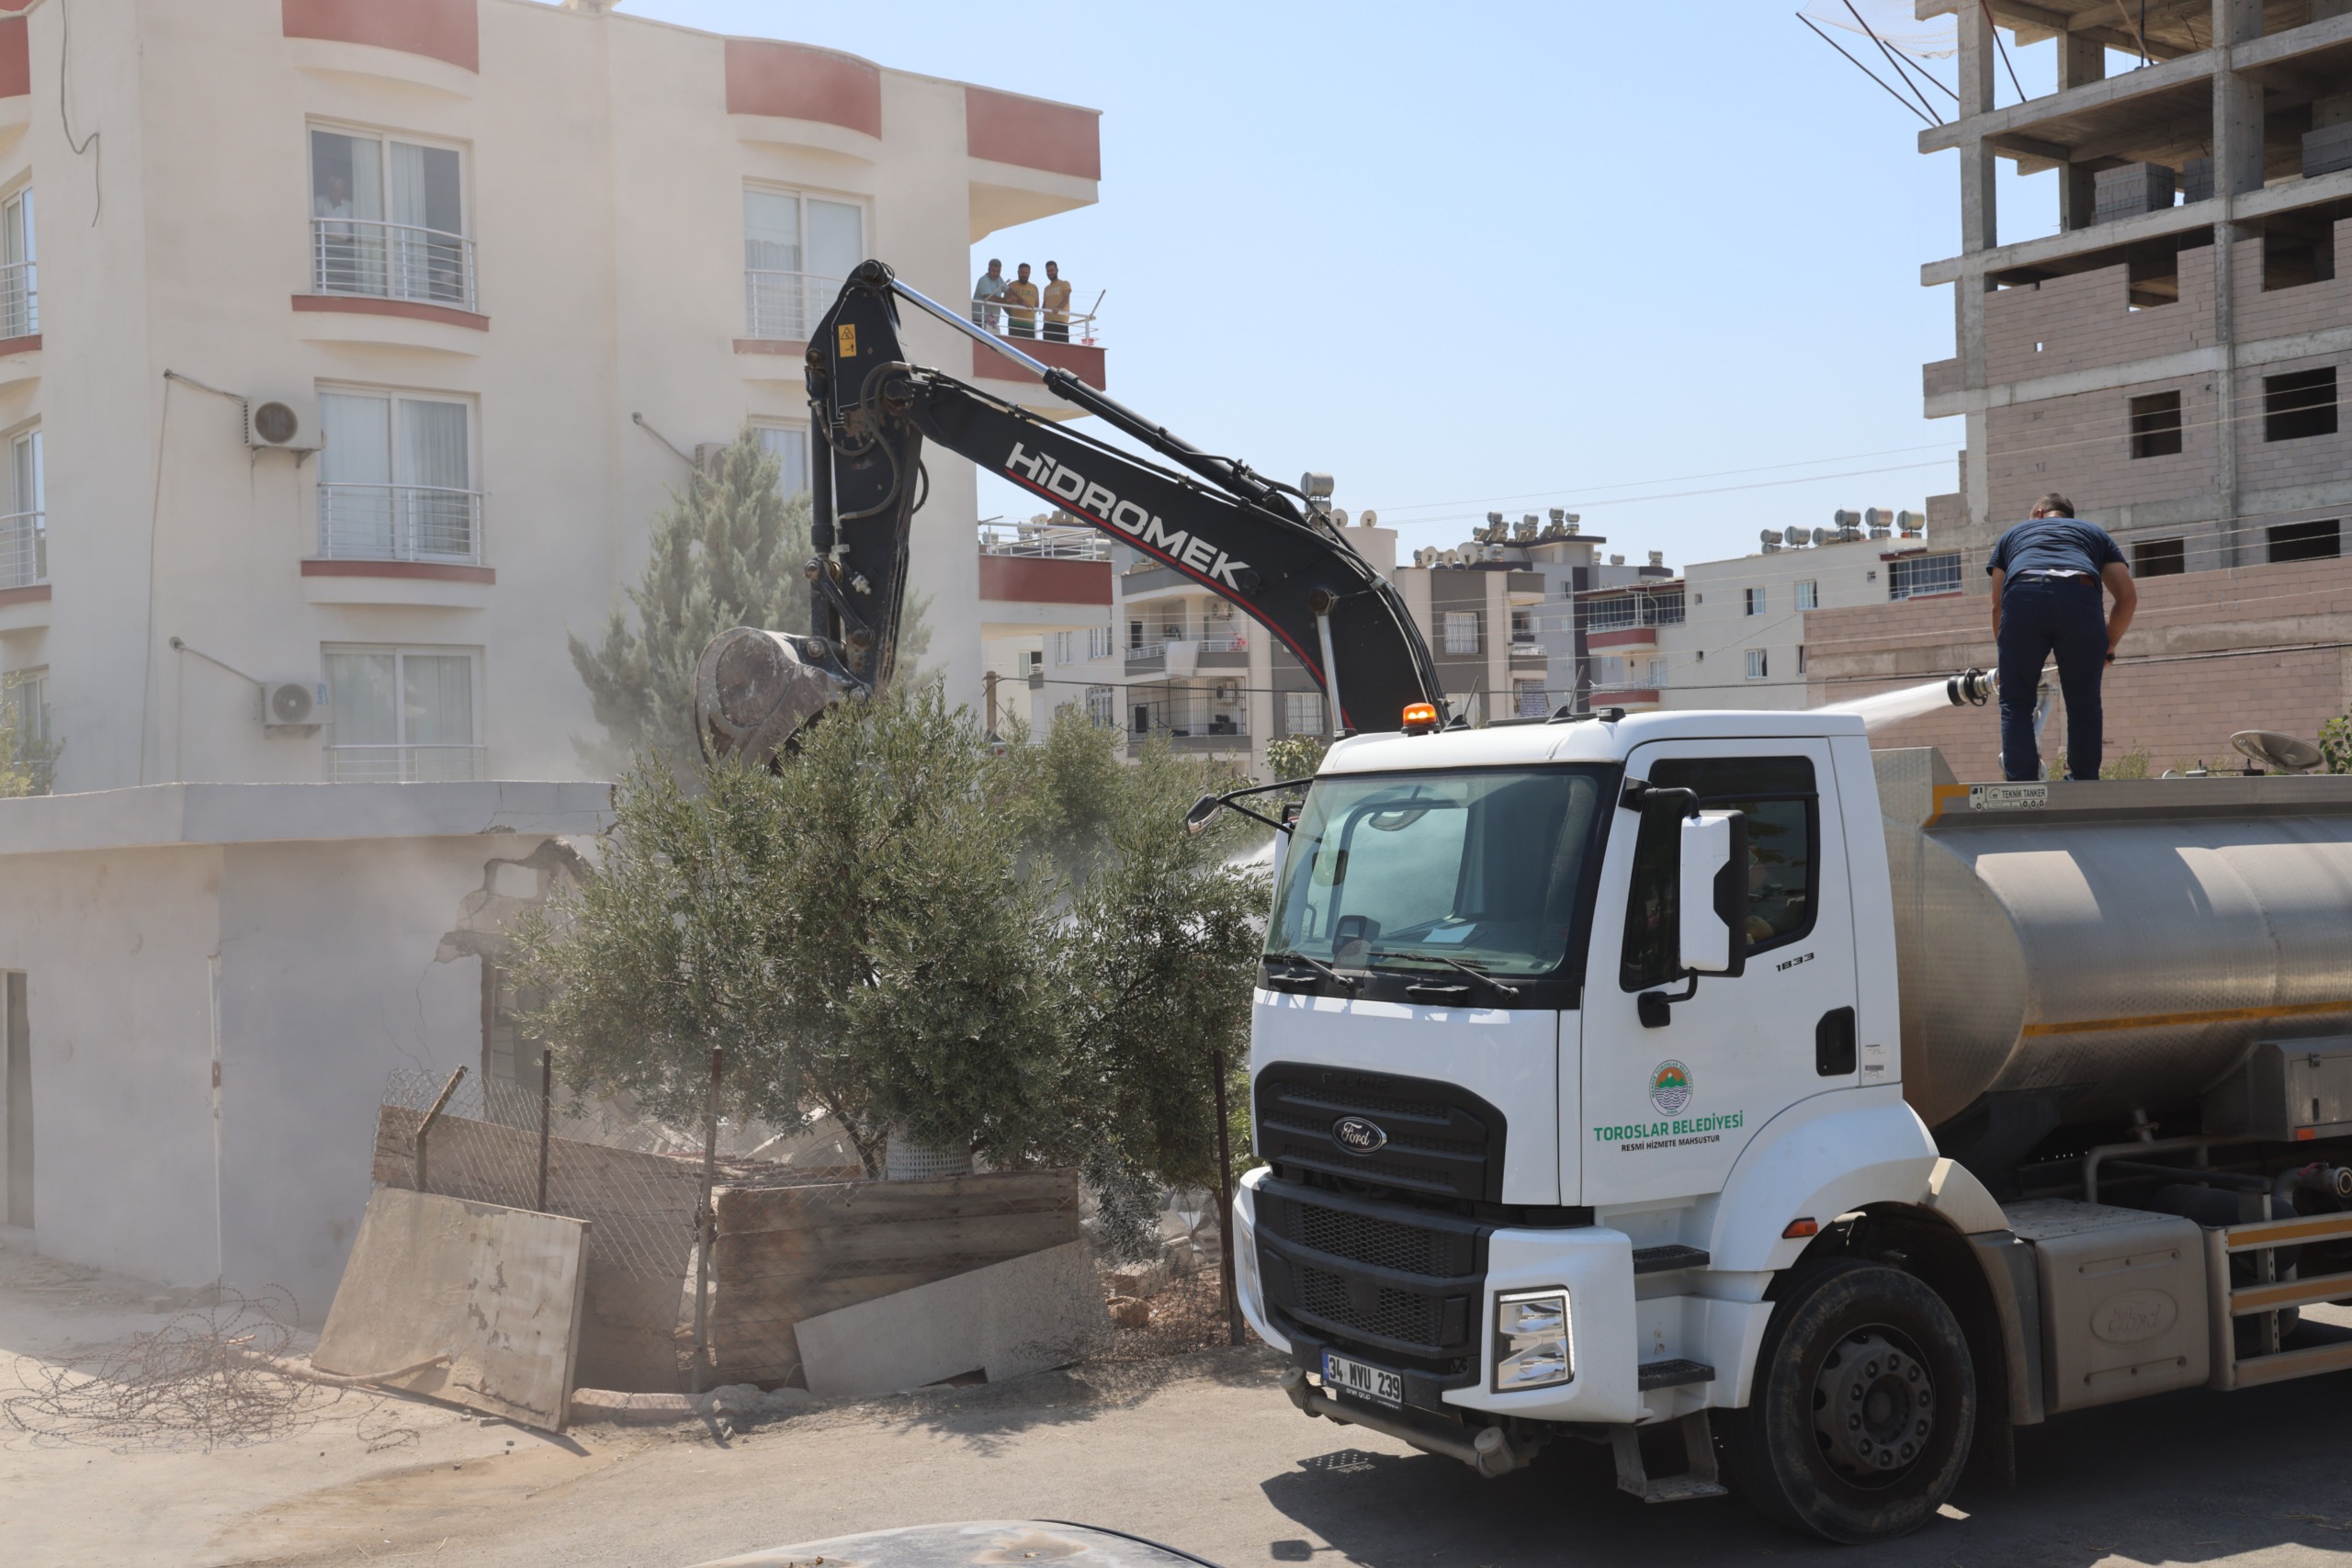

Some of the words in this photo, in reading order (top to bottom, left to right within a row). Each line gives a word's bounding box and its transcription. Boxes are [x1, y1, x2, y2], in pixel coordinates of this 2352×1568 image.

[2002, 787, 2022, 798] TEKNİK
[2023, 788, 2046, 798] TANKER
[1776, 952, 1815, 972] 1833
[1341, 1122, 1370, 1145] Ford
[1593, 1122, 1669, 1142] TOROSLAR
[1672, 1110, 1744, 1134] BELEDİYESİ
[1646, 1138, 1677, 1149] HİZMETE
[1679, 1134, 1720, 1146] MAHSUSTUR
[2109, 1301, 2162, 1334] Ford
[1329, 1358, 1343, 1382] 34
[1350, 1363, 1371, 1390] MVU
[1377, 1371, 1400, 1400] 239
